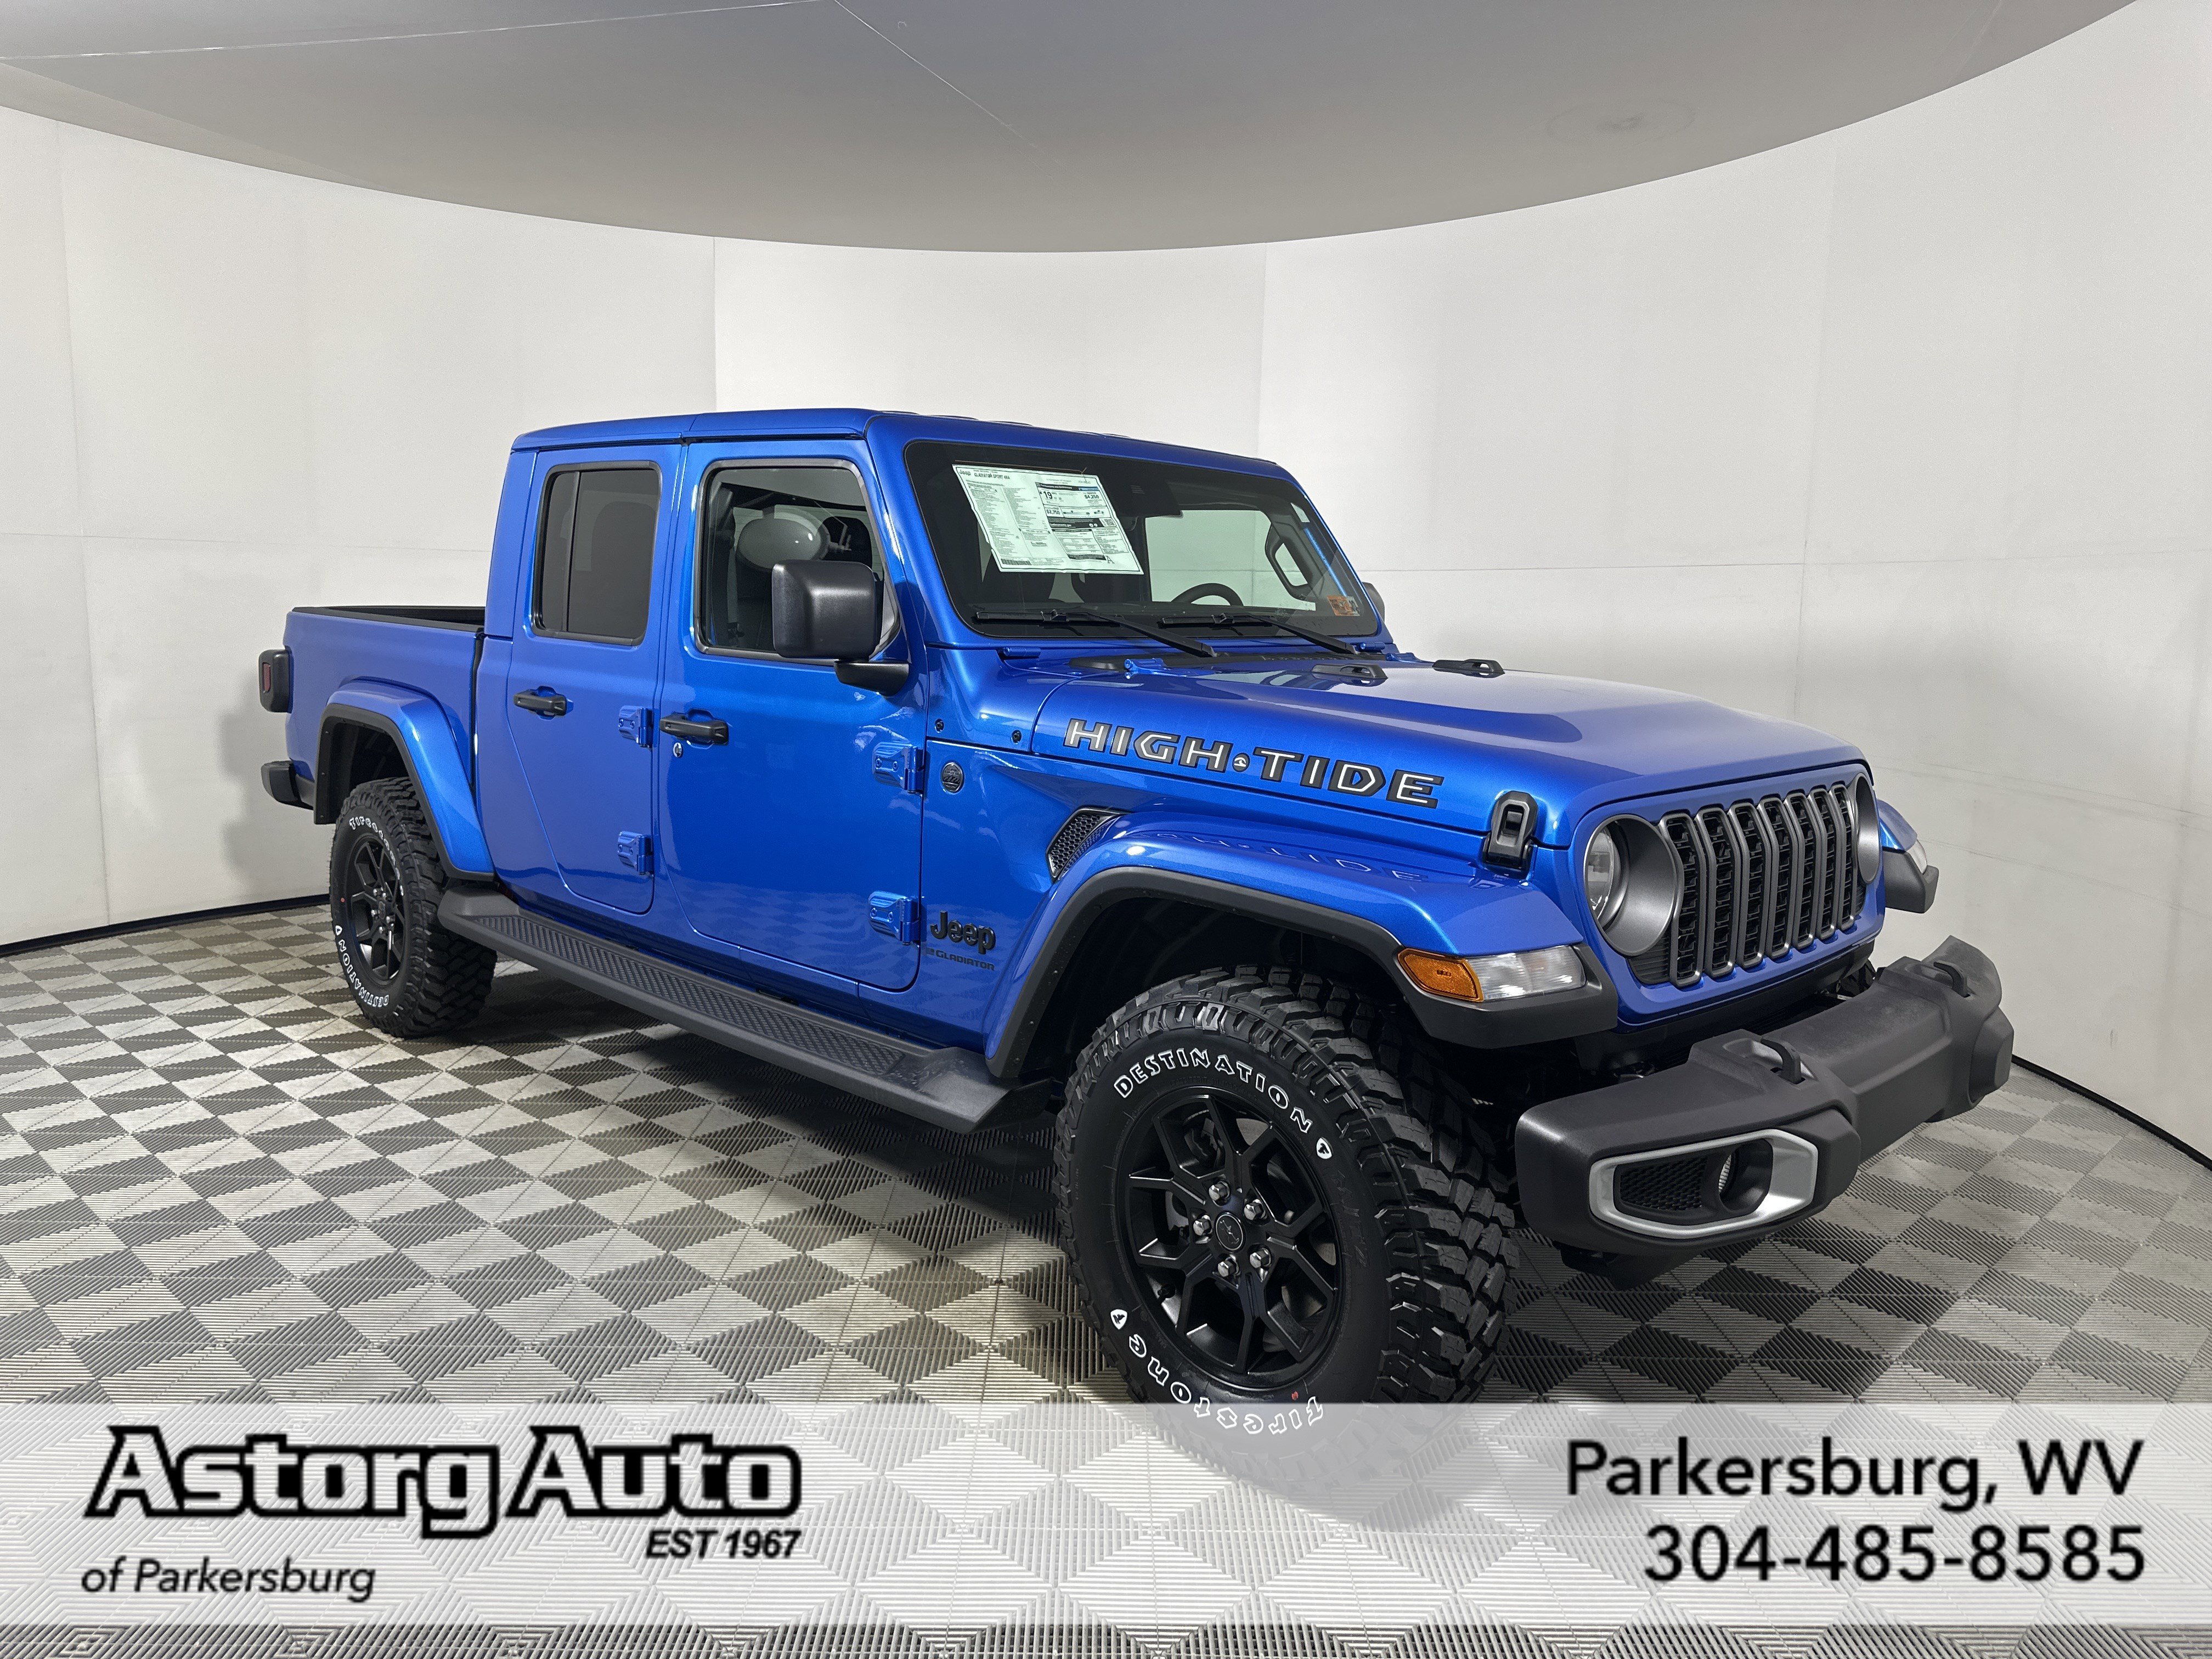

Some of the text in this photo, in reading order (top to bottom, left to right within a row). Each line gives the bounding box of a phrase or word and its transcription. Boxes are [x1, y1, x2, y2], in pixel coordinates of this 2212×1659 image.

[1043, 491, 1052, 499] 19
[1063, 718, 1444, 809] HIGH TIDE
[930, 911, 996, 955] Jeep
[935, 950, 995, 971] GLADIATOR
[338, 939, 390, 1007] DESTINATION
[1114, 1047, 1313, 1134] DESTINATION
[1128, 1334, 1323, 1435] Firestone
